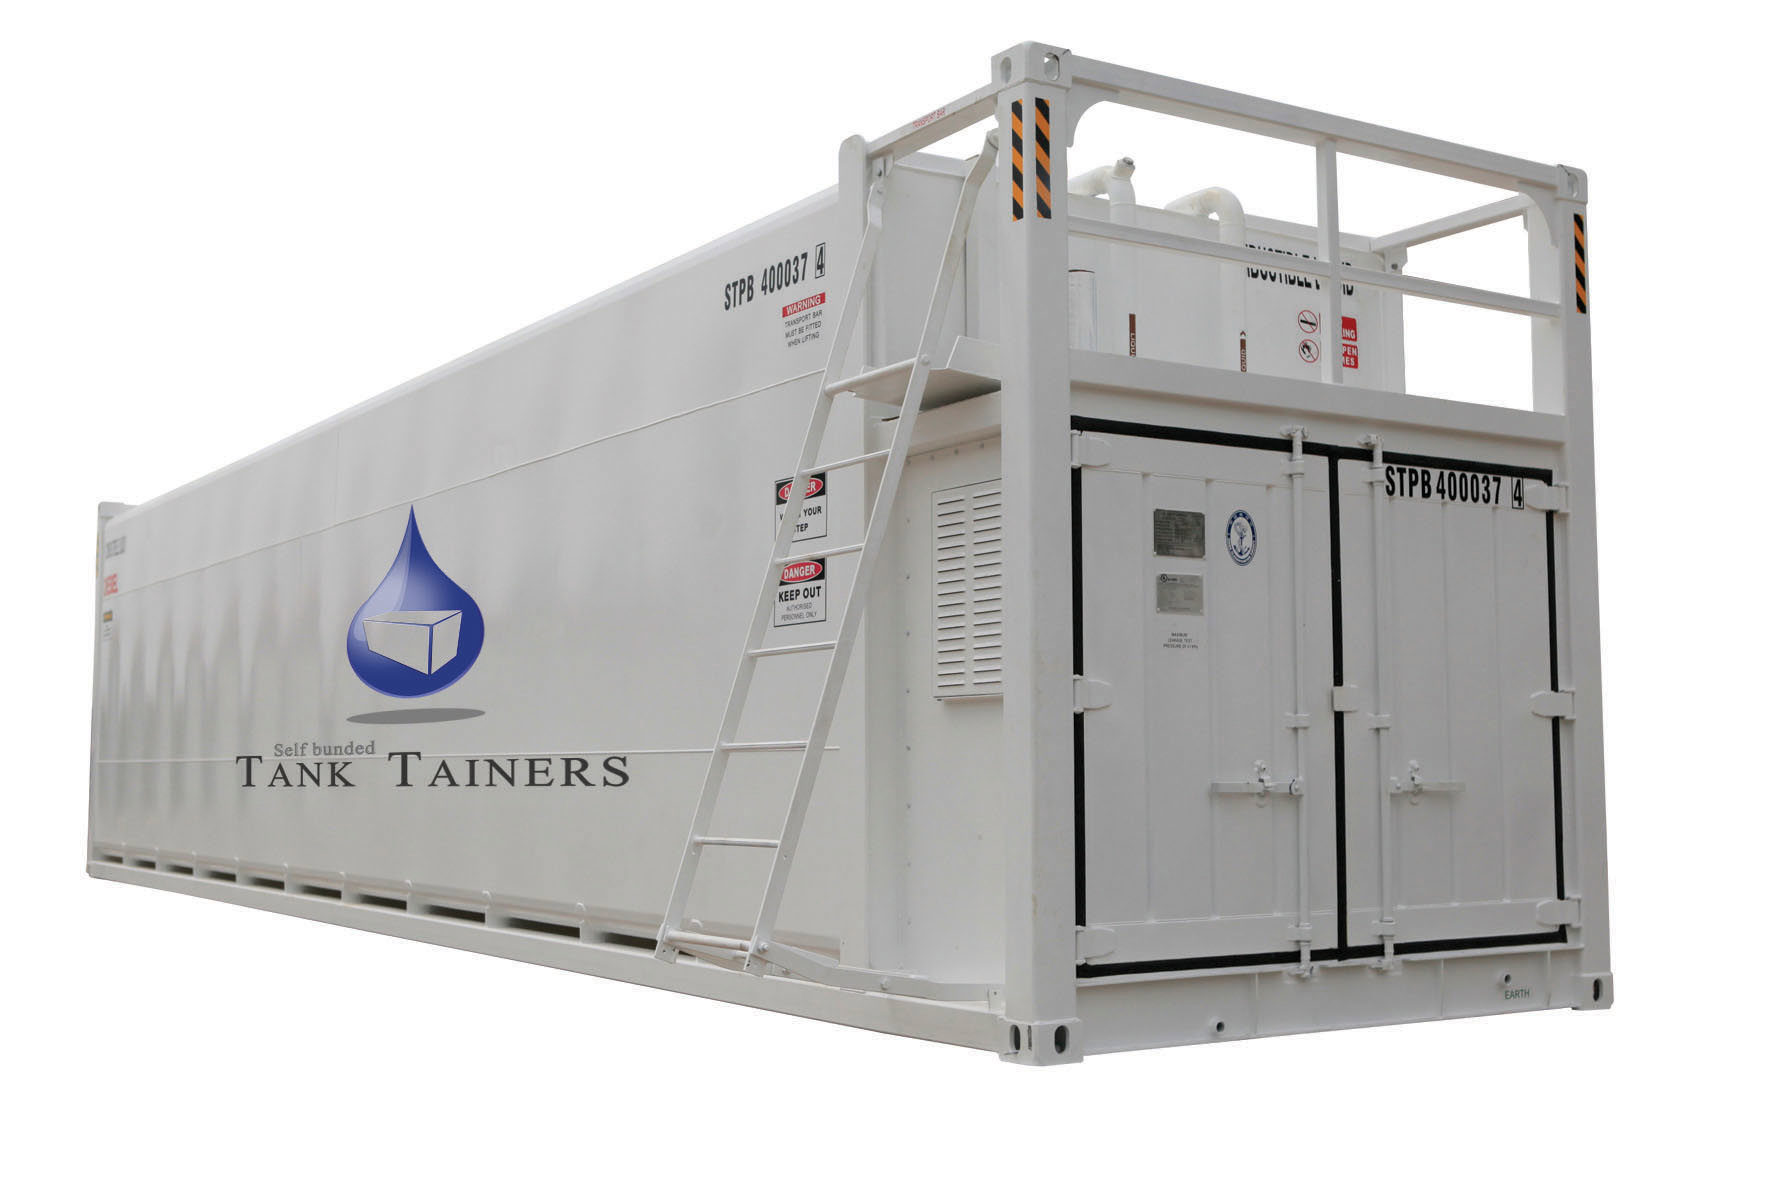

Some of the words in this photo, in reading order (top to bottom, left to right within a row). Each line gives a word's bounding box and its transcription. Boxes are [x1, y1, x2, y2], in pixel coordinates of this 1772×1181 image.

[724, 274, 754, 311] STPB
[761, 252, 808, 295] 400037
[816, 244, 825, 277] 4
[786, 295, 822, 316] WARNING
[784, 313, 811, 328] TRANSPORT
[812, 309, 823, 319] BAR
[785, 328, 798, 339] MUST
[798, 325, 805, 335] BE
[805, 320, 822, 332] FITTED
[787, 337, 801, 348] WHEN
[801, 331, 820, 344] LIFTING
[1385, 465, 1432, 499] STPB
[1436, 470, 1502, 505] 400037
[1512, 477, 1523, 508] 4
[803, 505, 822, 518] YOUR
[794, 523, 808, 533] TEP
[783, 564, 816, 580] DANGER
[778, 588, 801, 603] KEEP
[802, 585, 822, 600] OUT
[786, 602, 812, 611] AUTHORISED
[781, 611, 804, 621] PERSONNEL
[805, 610, 817, 619] ONLY
[273, 742, 309, 758] Self
[311, 740, 376, 757] bunded
[1504, 988, 1530, 1000] EARTH
